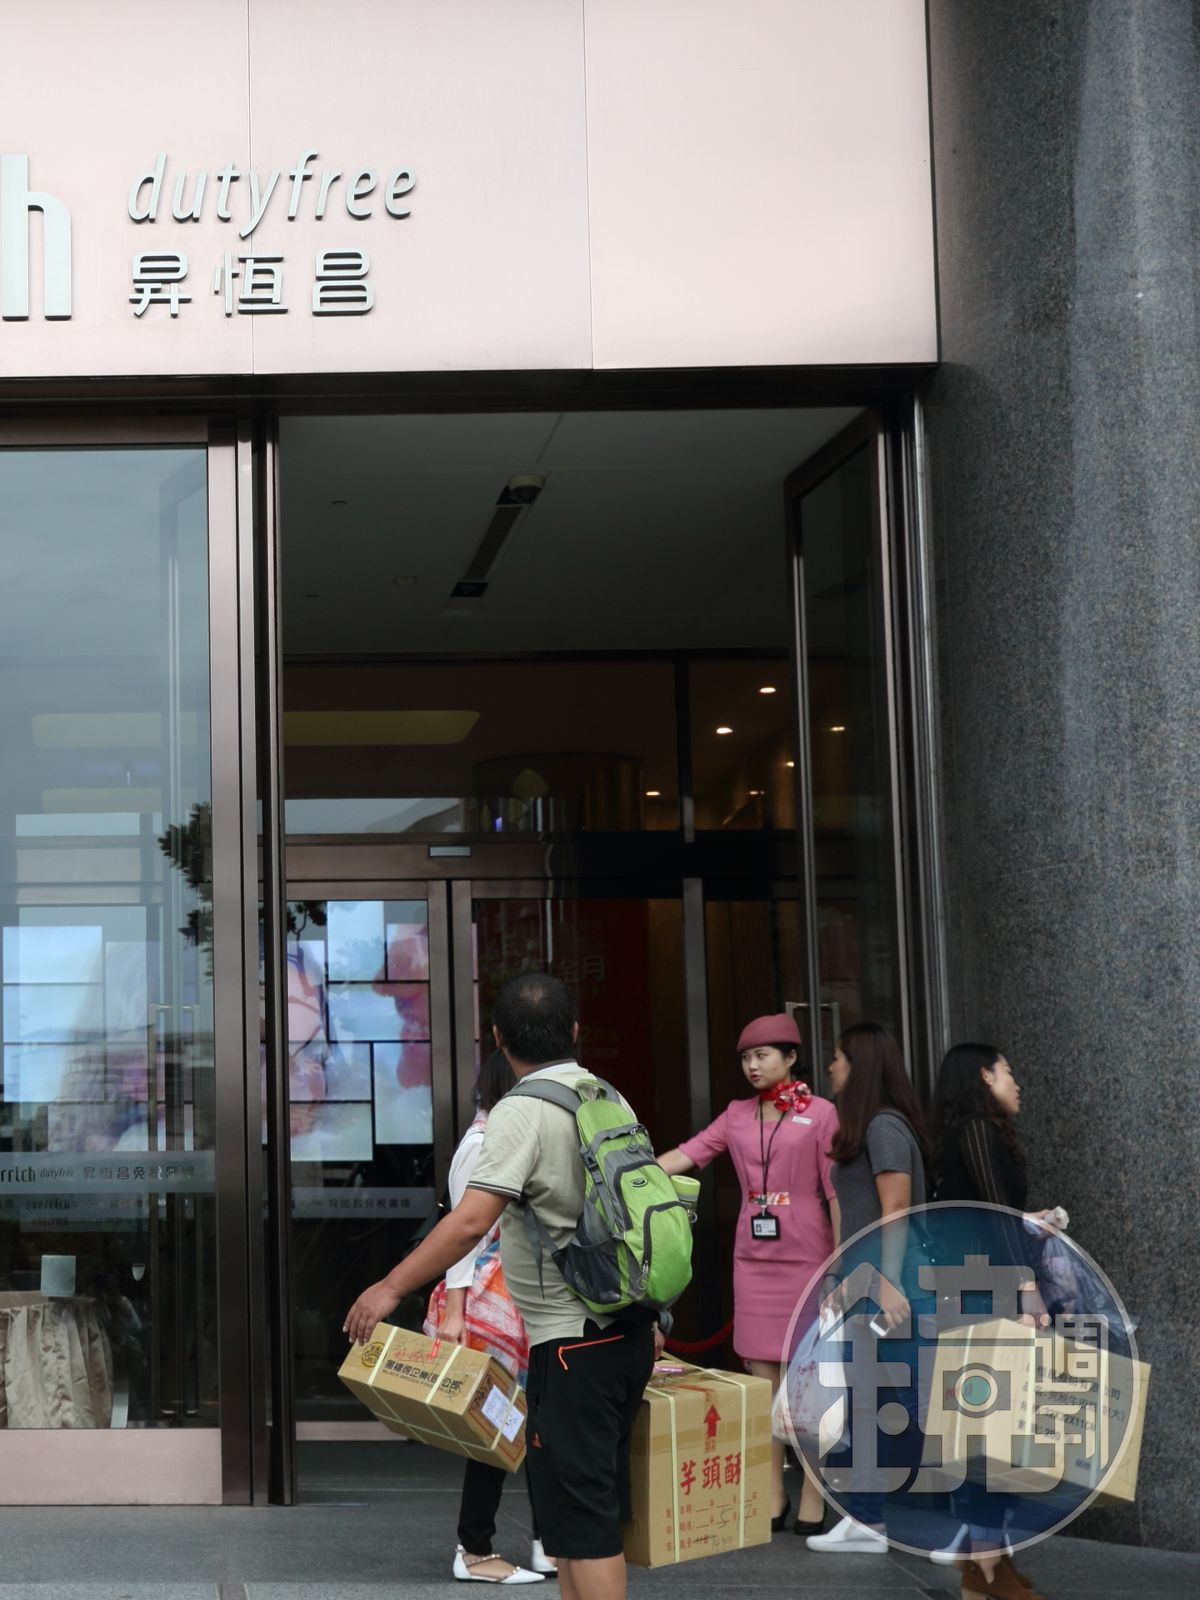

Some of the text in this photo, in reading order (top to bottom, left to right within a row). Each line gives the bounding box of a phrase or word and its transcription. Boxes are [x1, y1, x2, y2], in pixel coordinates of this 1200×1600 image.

[128, 149, 417, 239] dutyfree
[128, 248, 375, 318] 昇恒昌
[680, 1453, 741, 1497] 芋頭酥
